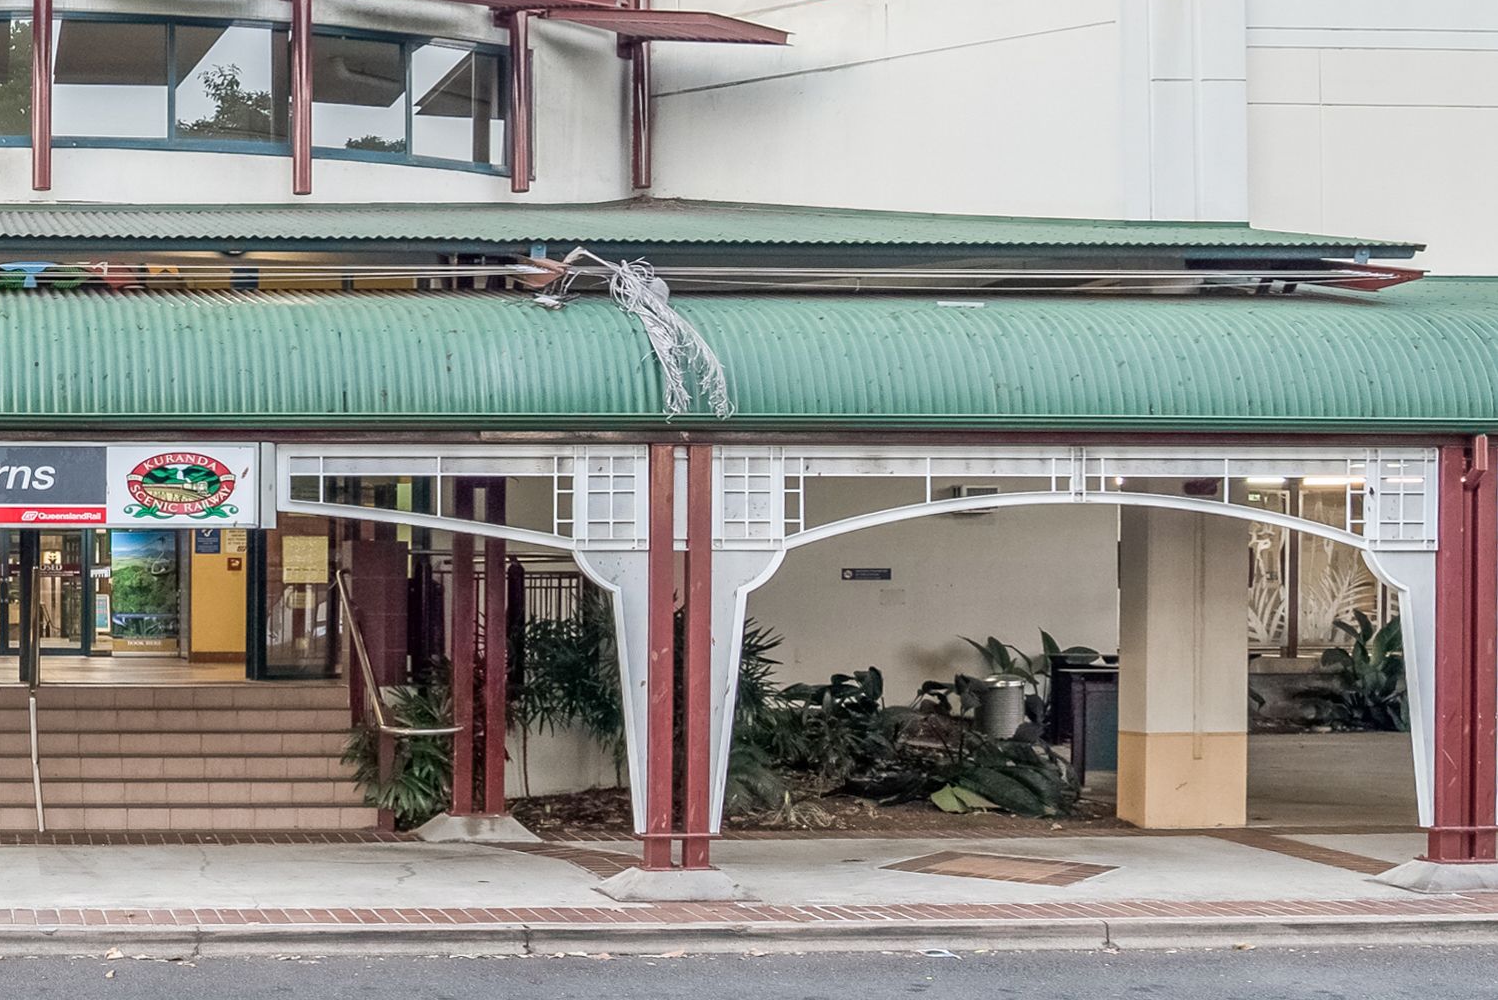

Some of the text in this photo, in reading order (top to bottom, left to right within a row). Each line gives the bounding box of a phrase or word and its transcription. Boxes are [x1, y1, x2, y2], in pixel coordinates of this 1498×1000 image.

[143, 453, 217, 471] KURANDA
[130, 484, 231, 513] SCENIC RAILWAY
